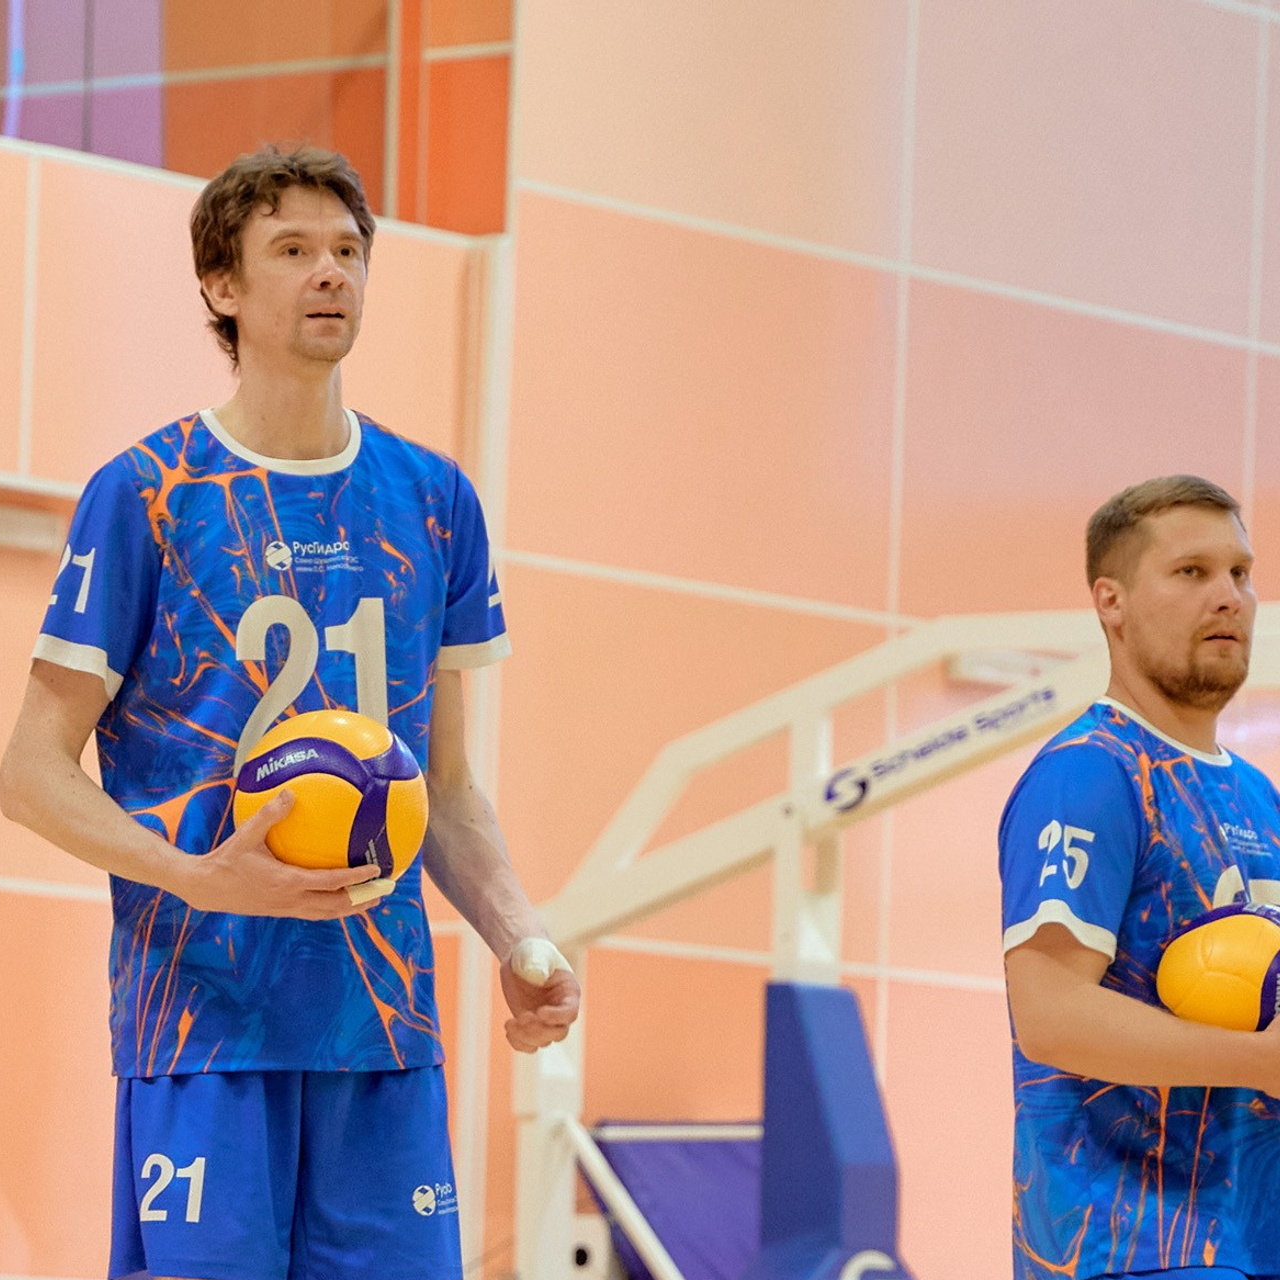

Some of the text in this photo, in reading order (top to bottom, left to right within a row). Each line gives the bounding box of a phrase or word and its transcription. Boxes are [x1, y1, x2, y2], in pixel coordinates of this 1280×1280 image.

[233, 595, 388, 778] 21
[1038, 819, 1096, 890] 25
[140, 1153, 206, 1223] 21
